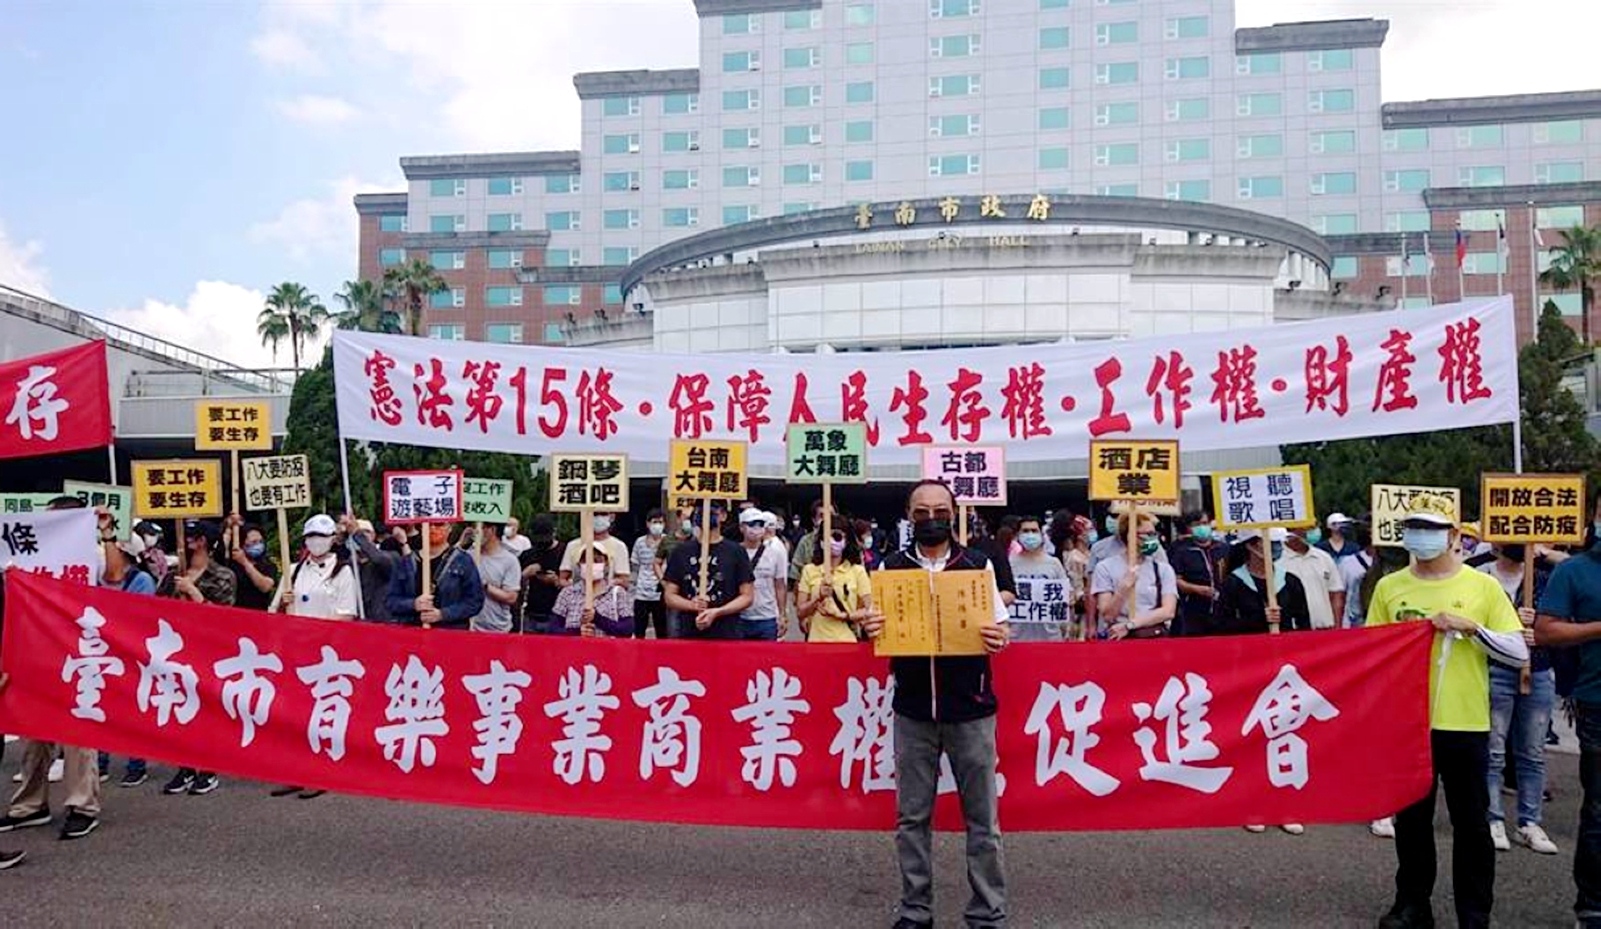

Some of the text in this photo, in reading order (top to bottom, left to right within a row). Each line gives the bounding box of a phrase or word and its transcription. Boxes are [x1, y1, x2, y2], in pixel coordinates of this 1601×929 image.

[854, 194, 1051, 230] 臺南市政府
[989, 235, 1028, 247] HALL
[5, 366, 69, 441] 存
[208, 407, 259, 423] 要工作
[208, 426, 259, 443] 要生存
[804, 430, 848, 452] 萬象
[687, 446, 730, 469] 台南
[793, 454, 861, 477] 大舞廳
[941, 451, 987, 474] 古都
[1098, 447, 1171, 471] 酒店
[146, 468, 206, 487] 要工作
[558, 459, 621, 481] 鋼琴
[675, 470, 741, 494] 大舞廳
[1117, 472, 1152, 496] 業
[1226, 474, 1293, 500] 視聽
[147, 490, 208, 509] 要生存
[558, 483, 621, 505] 酒吧
[1489, 487, 1578, 508] 開放合法
[1228, 499, 1295, 524] 歌唱
[1489, 515, 1578, 536] 配合防疫
[2, 522, 39, 556] 條
[62, 606, 1340, 797] 臺南市育樂事業商業權促進會
